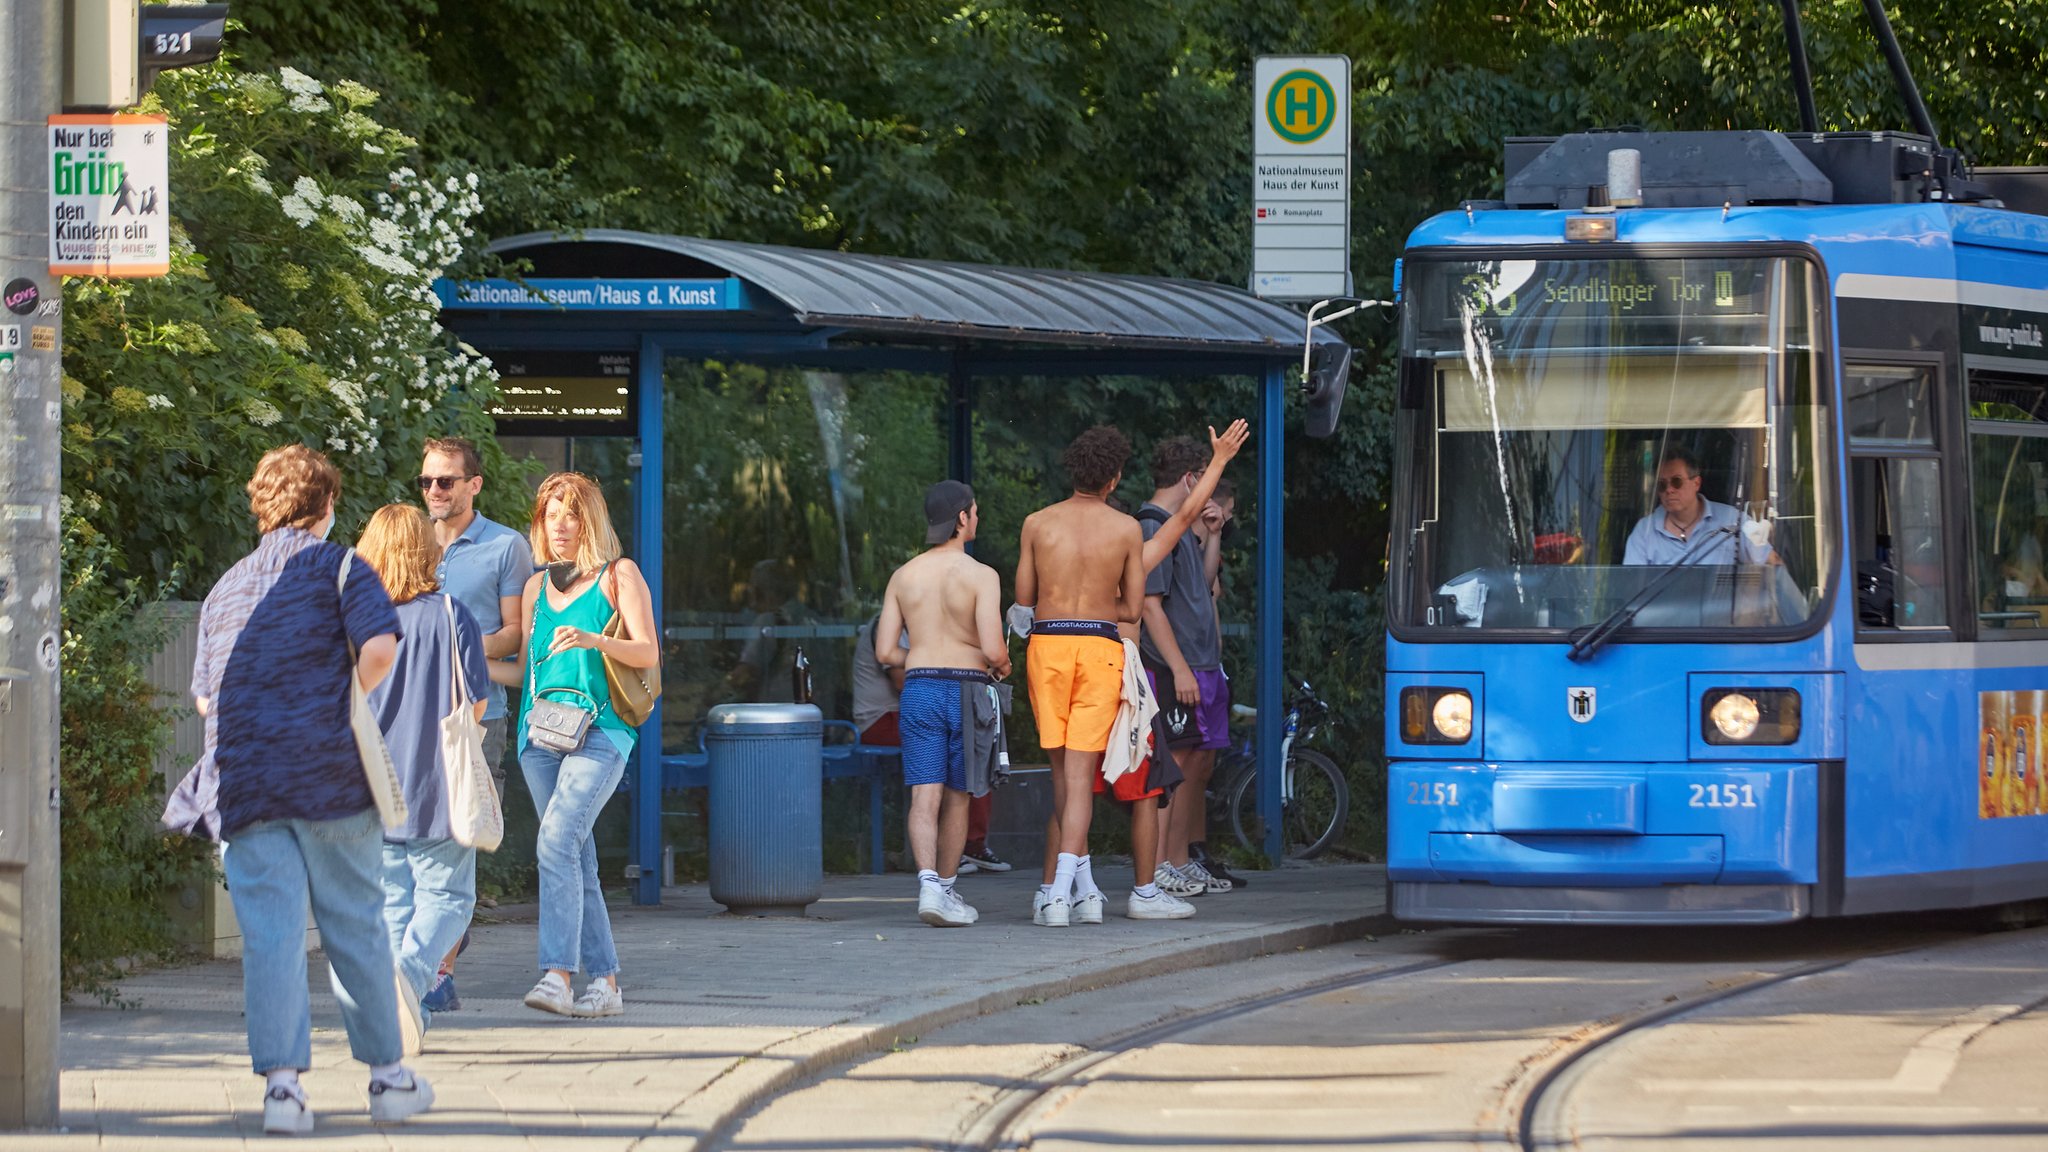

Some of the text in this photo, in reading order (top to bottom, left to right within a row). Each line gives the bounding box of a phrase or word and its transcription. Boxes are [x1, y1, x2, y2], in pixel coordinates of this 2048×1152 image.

[155, 31, 192, 54] 521
[1285, 87, 1317, 126] H
[55, 128, 115, 147] Nur bei
[54, 151, 126, 196] Grün
[1258, 164, 1344, 177] Nationalmuseum
[1263, 180, 1339, 190] Haus der Kunst
[55, 201, 84, 220] den
[1267, 208, 1277, 216] 16
[1284, 208, 1323, 218] Romanplatz
[55, 221, 148, 241] Kindern ein
[5, 286, 37, 307] LOVE
[647, 286, 663, 305] d.
[669, 286, 717, 305] Kunst
[1544, 276, 1658, 310] Sendlinger
[1668, 276, 1704, 302] Tor
[509, 364, 525, 374] Ziel
[598, 355, 631, 364] Abfahrt
[603, 365, 631, 375] in Min
[1427, 606, 1443, 626] 01
[1407, 782, 1459, 806] 2151
[1689, 783, 1757, 808] 2151
